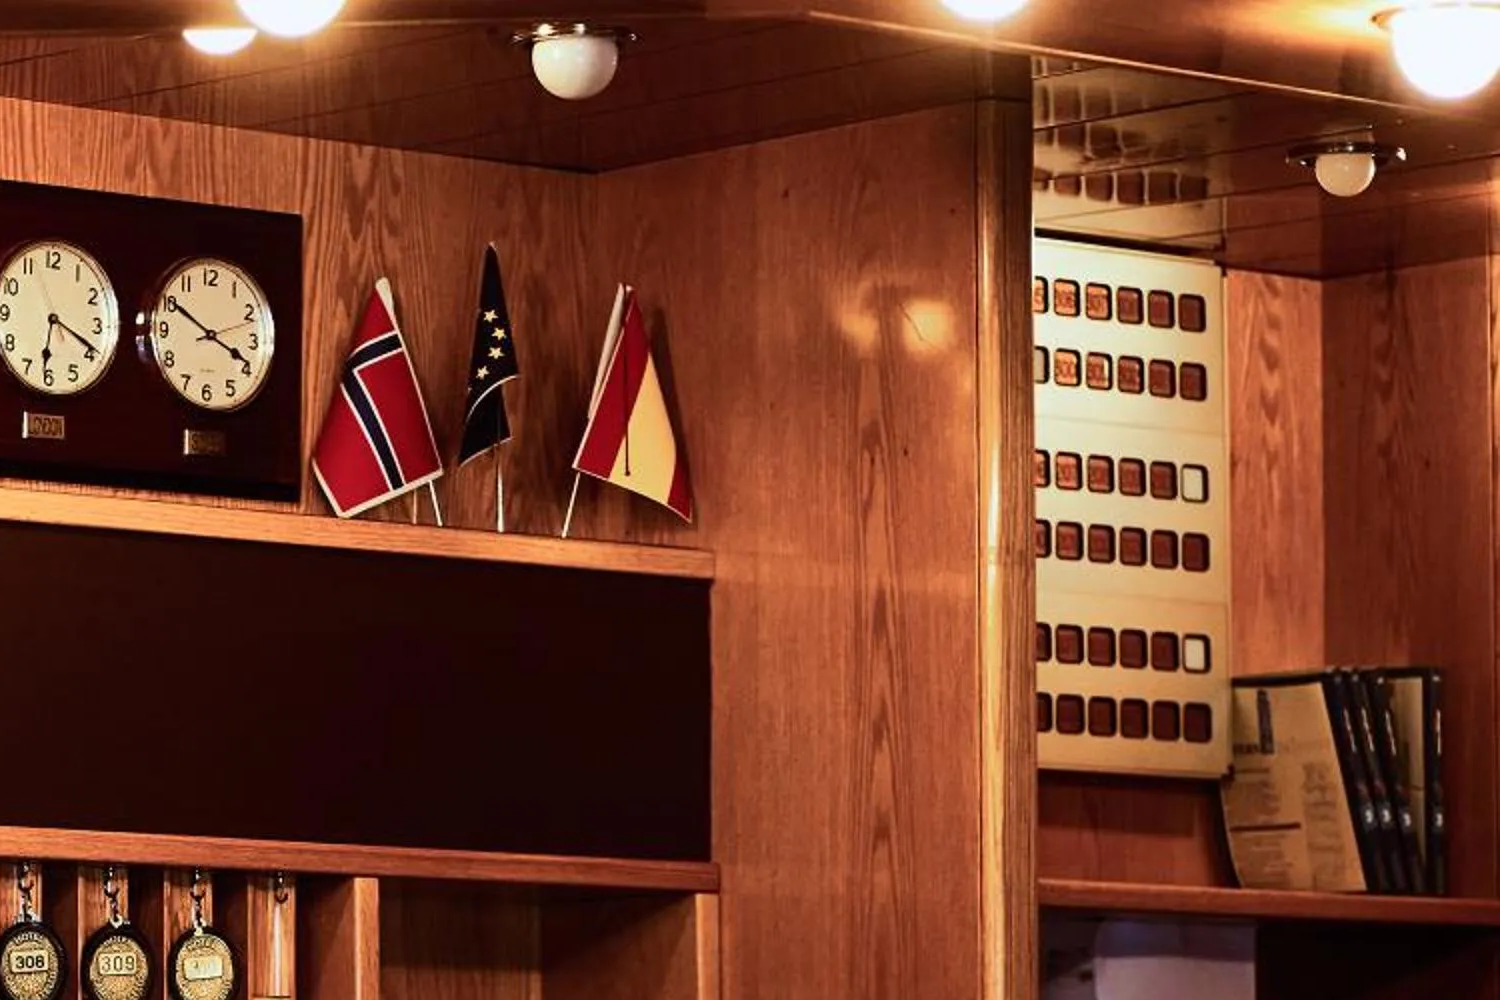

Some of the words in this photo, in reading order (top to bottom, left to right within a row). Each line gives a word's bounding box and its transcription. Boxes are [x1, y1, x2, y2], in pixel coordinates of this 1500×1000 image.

[24, 258, 32, 275] 11
[46, 251, 60, 269] 12
[182, 275, 190, 292] 11
[204, 268, 218, 286] 12
[4, 278, 19, 296] 10
[88, 288, 98, 305] 2
[163, 294, 176, 312] 10
[0, 304, 10, 321] 9
[244, 304, 254, 322] 2
[92, 318, 102, 334] 3
[160, 322, 168, 338] 9
[6, 334, 15, 351] 8
[249, 334, 258, 350] 3
[84, 346, 94, 362] 4
[164, 351, 174, 368] 8
[22, 358, 32, 375] 7
[68, 364, 78, 382] 5
[242, 361, 251, 376] 4
[44, 370, 53, 386] 6
[181, 374, 191, 390] 7
[202, 385, 212, 401] 6
[226, 380, 235, 397] 5
[101, 956, 135, 972] 309
